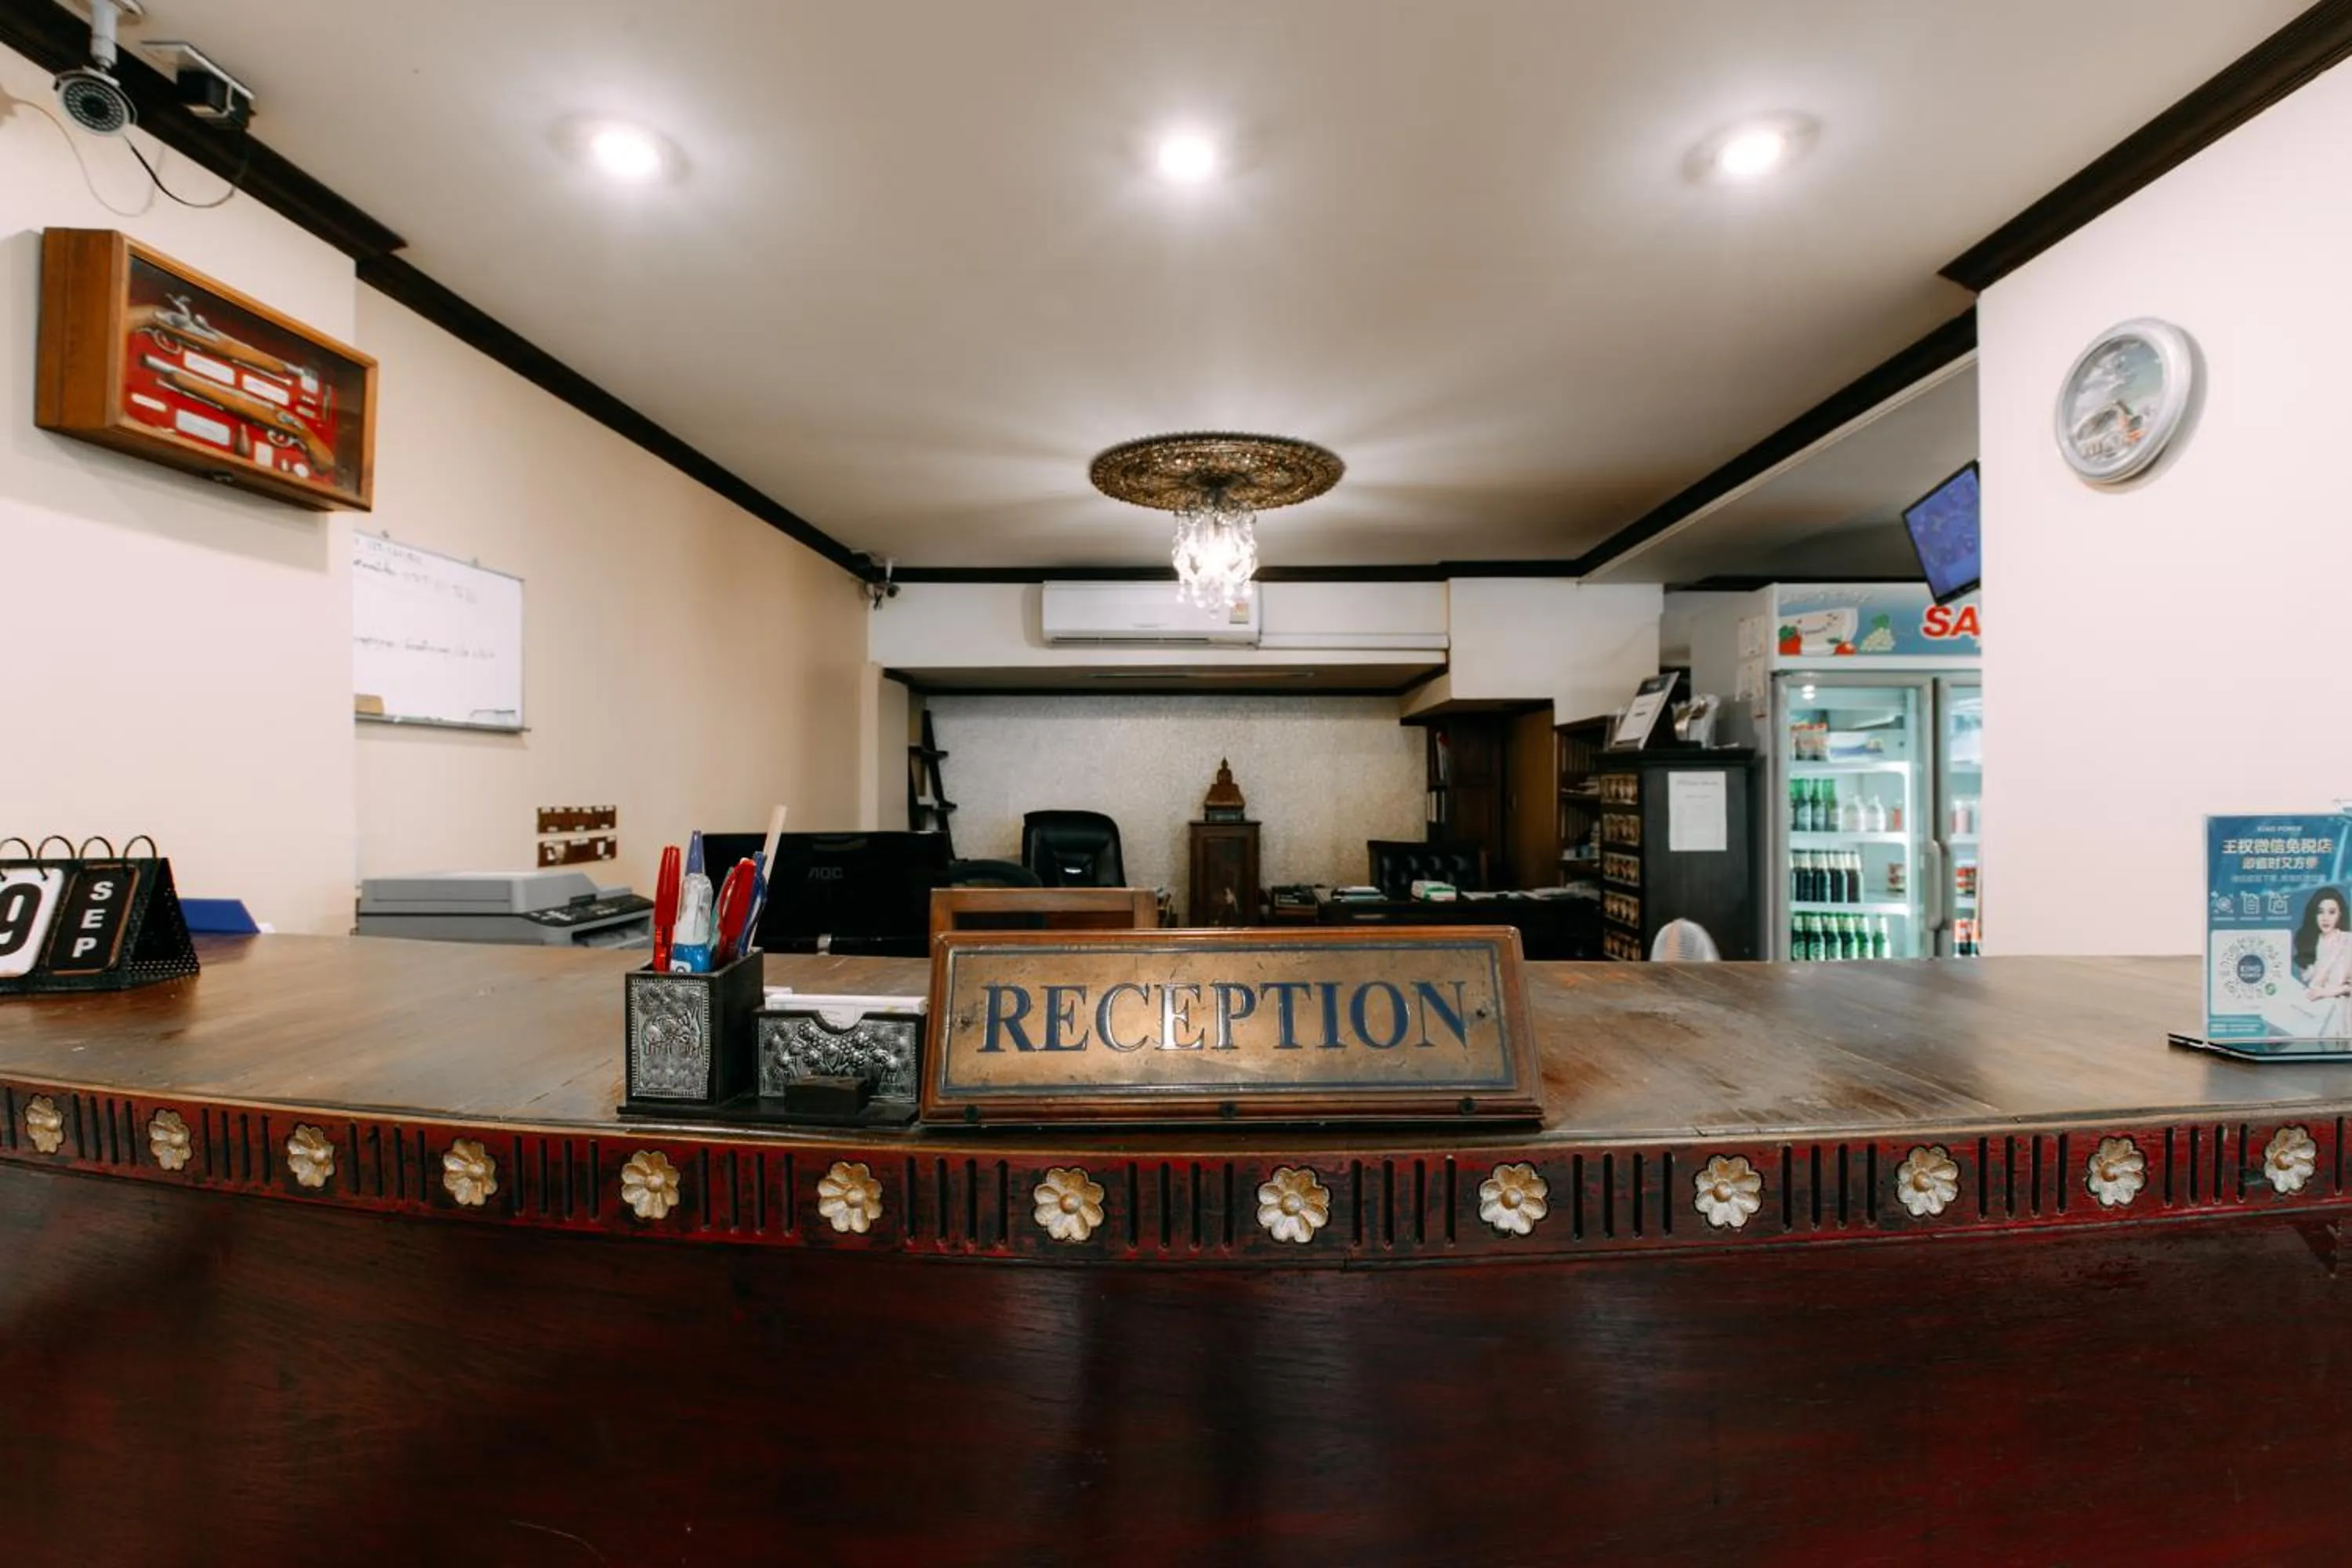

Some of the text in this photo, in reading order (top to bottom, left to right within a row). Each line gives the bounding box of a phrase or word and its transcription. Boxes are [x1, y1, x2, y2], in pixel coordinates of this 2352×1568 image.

[808, 866, 844, 879] AOC
[72, 881, 114, 958] SEP
[975, 980, 1470, 1053] RECEPTION
